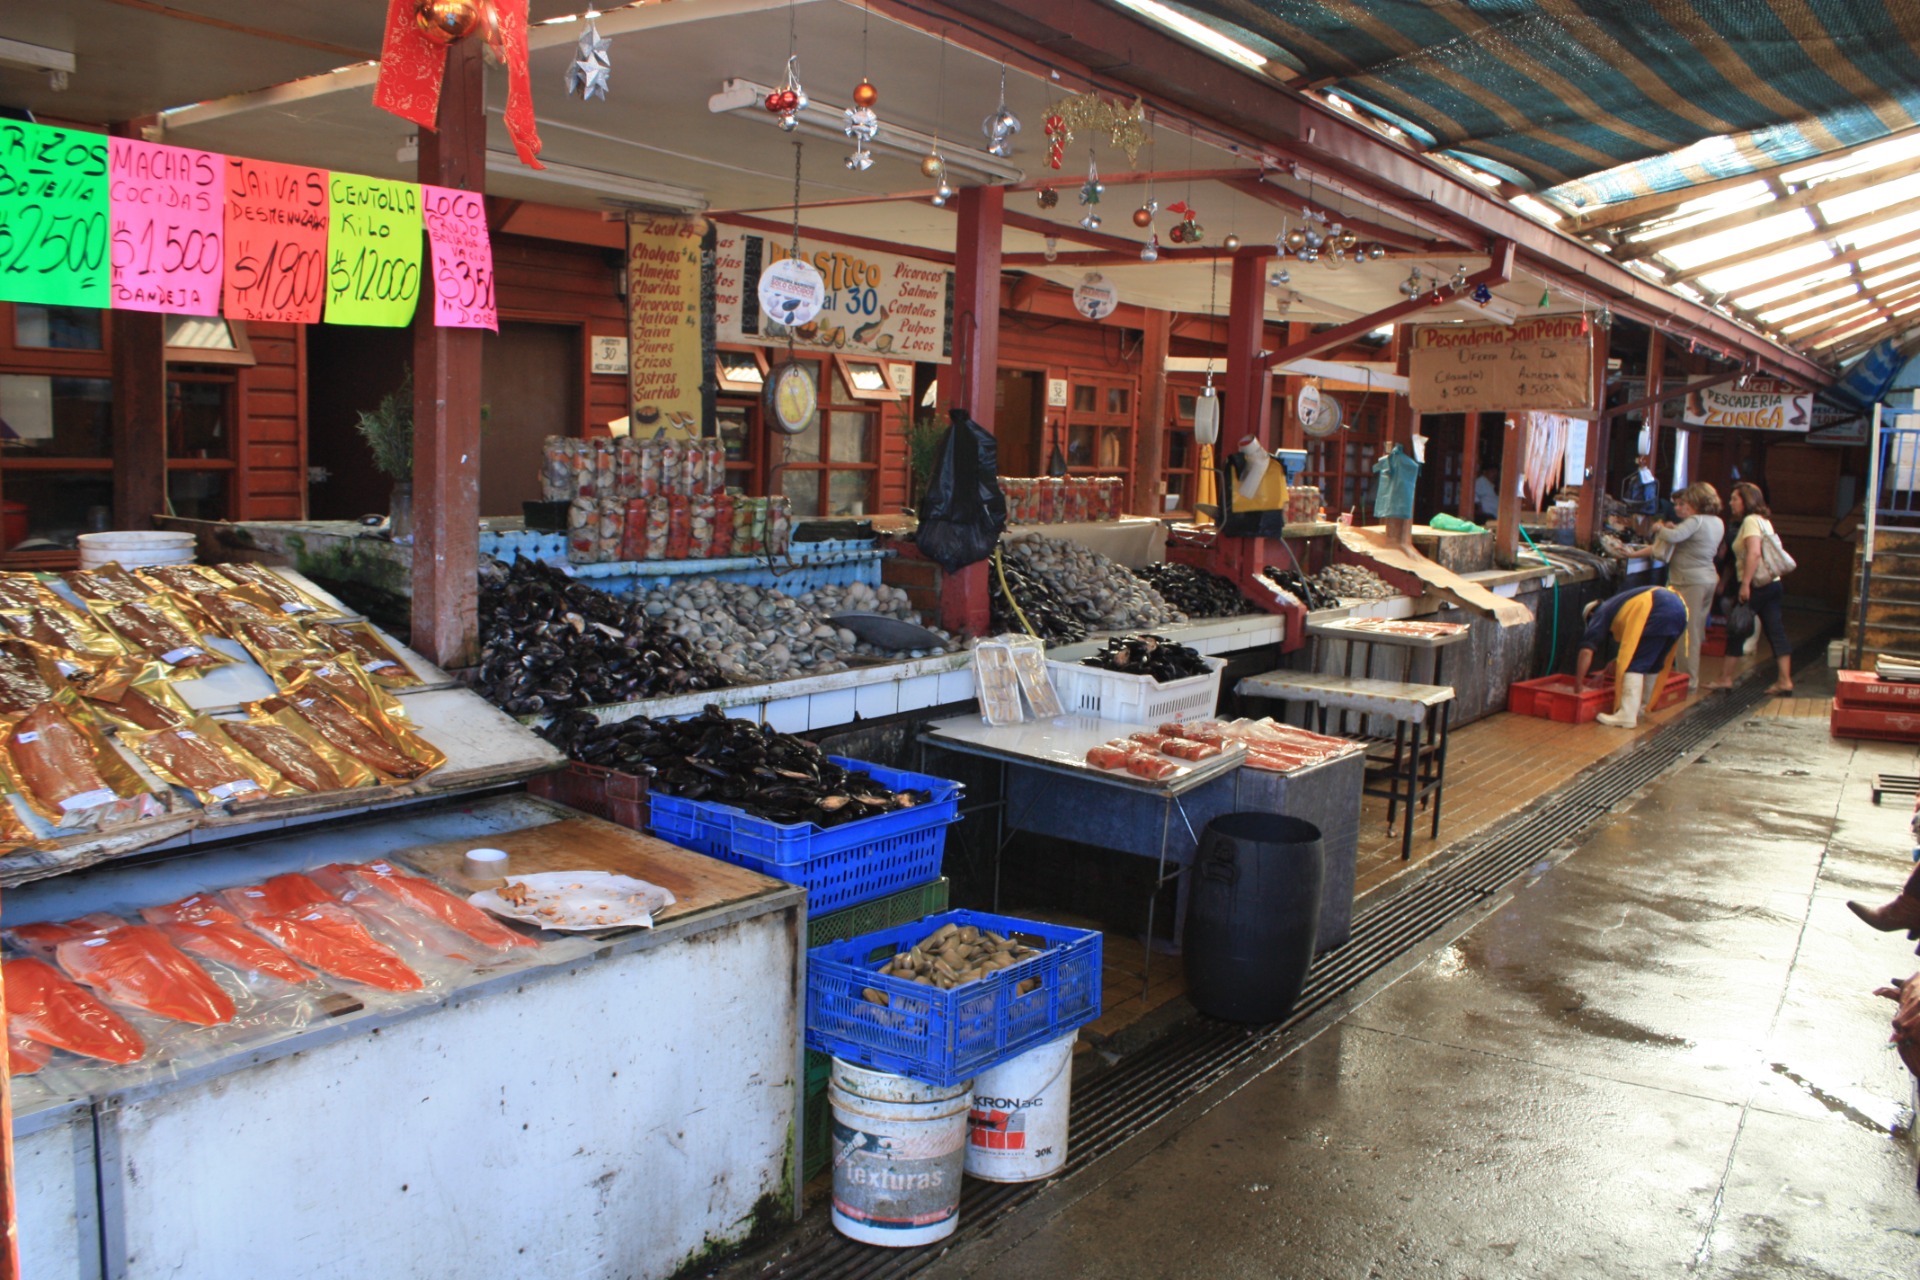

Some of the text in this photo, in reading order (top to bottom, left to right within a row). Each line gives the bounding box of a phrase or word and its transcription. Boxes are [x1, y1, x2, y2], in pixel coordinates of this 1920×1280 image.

[0, 126, 108, 176] RiZOS
[112, 144, 214, 186] MACHAS
[331, 179, 415, 215] CENTOLLA
[424, 189, 480, 219] LOCO
[632, 242, 680, 264] Cholgas
[716, 254, 742, 269] ejas
[632, 262, 681, 281] Almejas
[893, 261, 942, 283] Picorocos
[111, 283, 201, 308] BANDEJA
[632, 280, 681, 295] Choritos
[898, 281, 938, 299] Salmón
[632, 295, 684, 312] Picorocos
[845, 287, 878, 316] 30
[888, 299, 936, 318] Centollas
[633, 325, 671, 340] Jaiva
[898, 318, 936, 336] Pulpos
[1505, 324, 1535, 345] San
[633, 339, 674, 356] Piures
[901, 335, 935, 352] Locos
[602, 347, 617, 361] 30
[633, 355, 672, 369] Erizos
[634, 371, 677, 387] Ostras
[1734, 379, 1775, 393] Local
[633, 385, 680, 402] Surtido
[1708, 389, 1782, 408] PESCADERIA
[845, 1160, 945, 1190] Texturas
